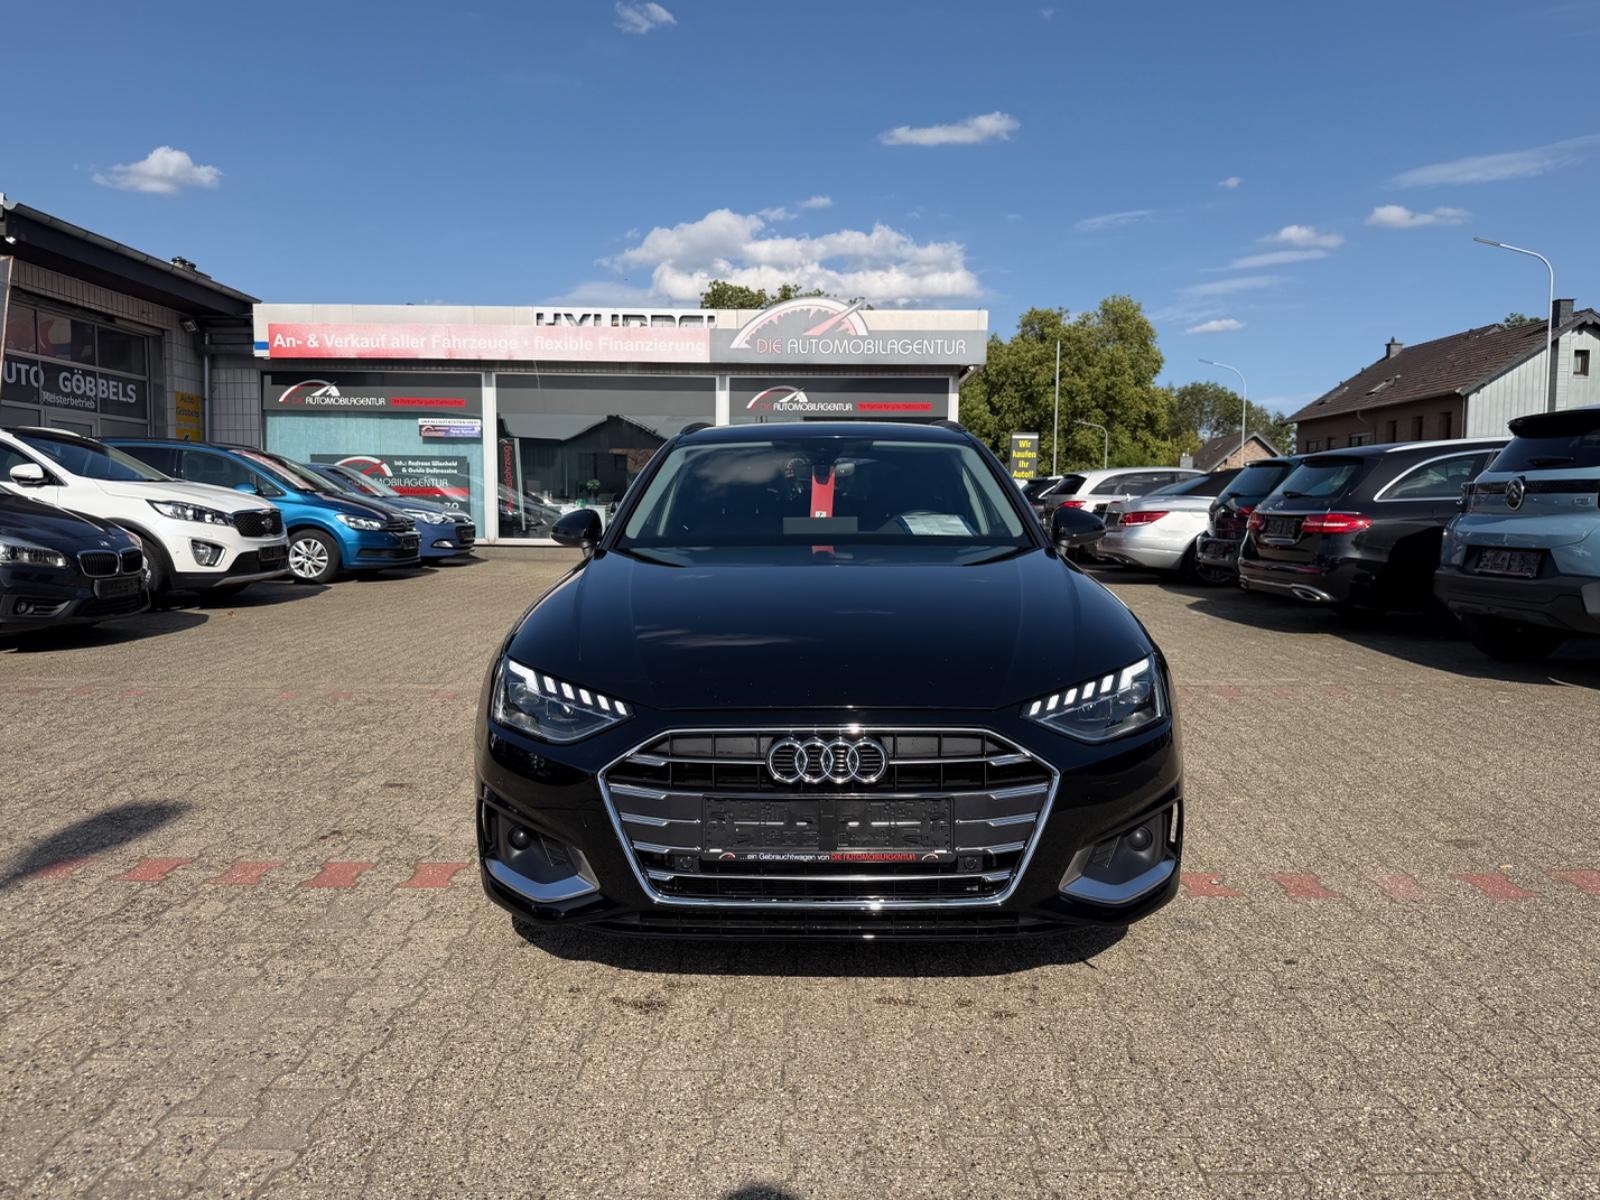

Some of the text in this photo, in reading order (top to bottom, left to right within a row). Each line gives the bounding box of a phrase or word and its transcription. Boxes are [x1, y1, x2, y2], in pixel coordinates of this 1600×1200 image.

[273, 333, 705, 356] An- & Verkauf aller Fahrzeuge flexible Finanzierung
[756, 338, 967, 355] DIE AUTOMOBILAGENTUR
[3, 361, 137, 404] UTO GÖBBELS
[42, 391, 96, 409] Meisterbetrieb
[1018, 439, 1031, 448] Wir
[1012, 450, 1037, 458] kaufen
[1018, 460, 1030, 468] Ihr
[759, 852, 816, 862] Gebrauchtwagen
